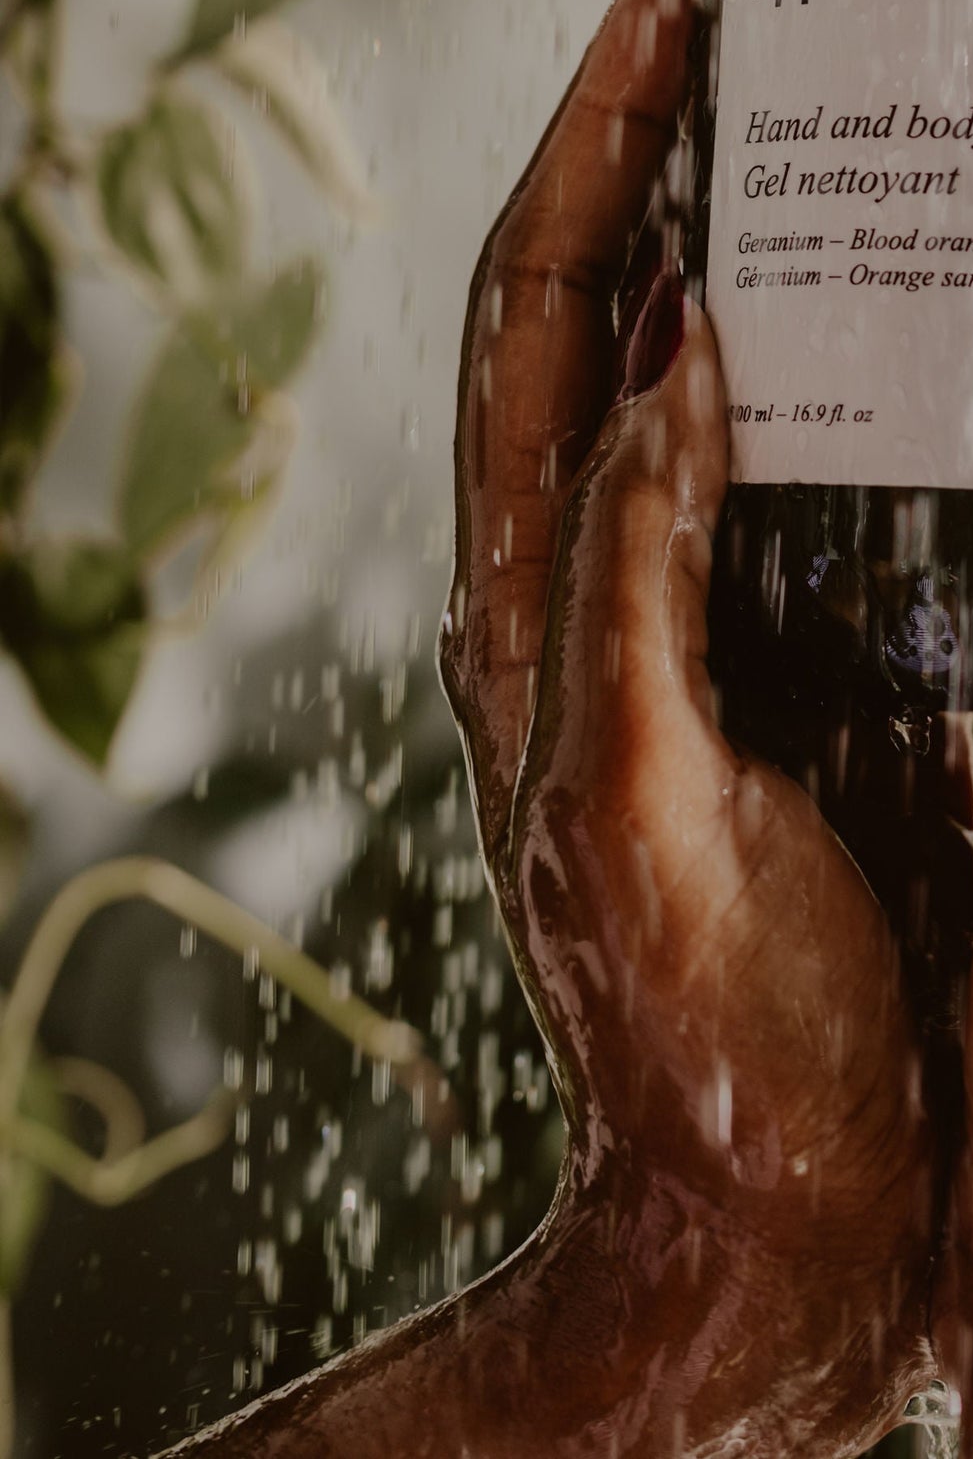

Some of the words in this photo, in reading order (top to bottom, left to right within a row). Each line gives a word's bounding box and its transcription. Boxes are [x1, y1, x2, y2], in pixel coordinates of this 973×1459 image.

[744, 106, 824, 144] Hand
[830, 105, 898, 140] and
[744, 163, 791, 199] Gel
[797, 165, 960, 203] nettoyant
[738, 230, 824, 255] Geranium
[850, 228, 919, 252] Blood
[735, 266, 822, 290] Géranium
[848, 263, 935, 291] Orange
[754, 404, 774, 422] ml
[791, 404, 826, 422] 16.9
[826, 404, 846, 426] fl.
[853, 410, 874, 423] oz
